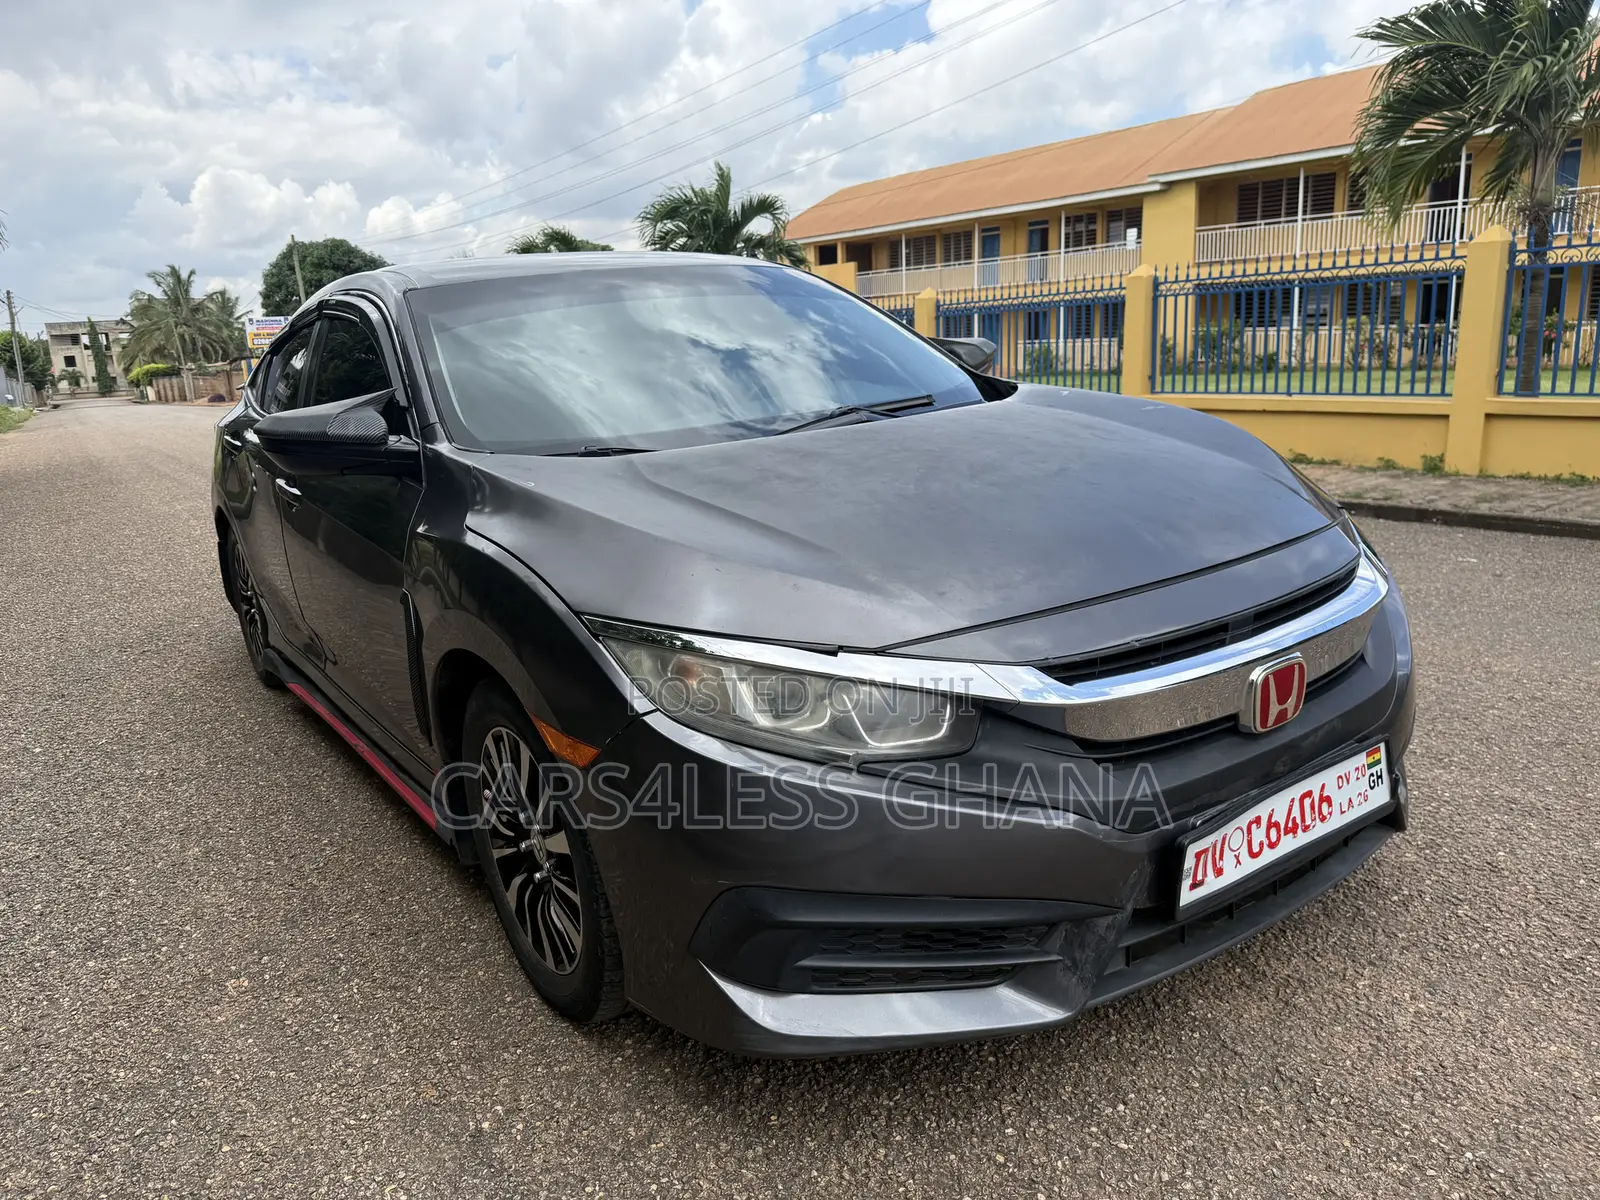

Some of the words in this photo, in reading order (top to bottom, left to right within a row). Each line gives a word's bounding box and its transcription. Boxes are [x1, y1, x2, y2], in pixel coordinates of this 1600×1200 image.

[1337, 770, 1351, 790] DV
[1354, 763, 1367, 781] 20
[1368, 768, 1384, 791] GH
[1339, 797, 1355, 815] LA
